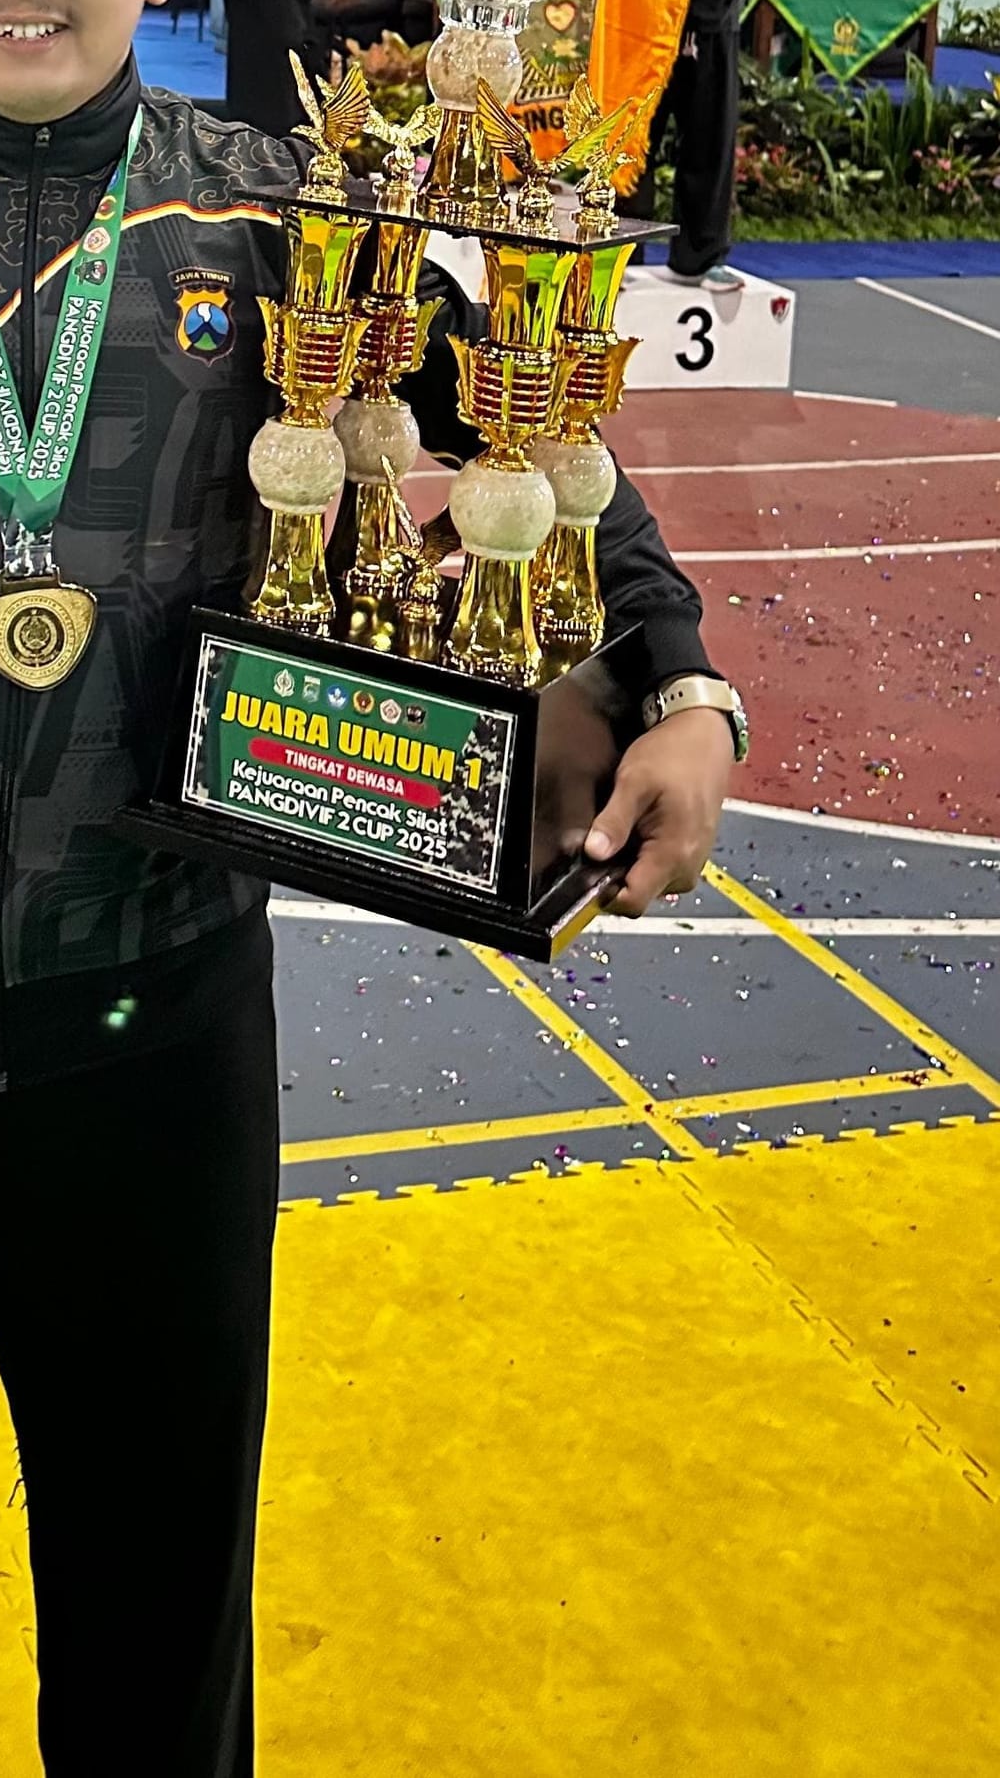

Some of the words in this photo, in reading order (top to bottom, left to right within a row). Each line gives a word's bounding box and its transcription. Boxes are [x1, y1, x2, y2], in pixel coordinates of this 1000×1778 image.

[175, 271, 200, 283] JAWA
[200, 272, 230, 283] TIMUR
[51, 296, 85, 387] PANGDIVIF
[72, 299, 102, 381] Kejuaraan
[675, 306, 714, 372] 3
[40, 401, 61, 436] CUP
[48, 388, 64, 399] 2
[58, 383, 85, 442] Pencak
[27, 438, 52, 480] 2025
[46, 446, 69, 480] Silat
[220, 690, 329, 749] JUARA
[338, 721, 456, 783] UMUM
[464, 757, 482, 791] 1
[233, 759, 328, 802] Kejuaraan
[330, 786, 402, 822] Pencak
[406, 809, 448, 836] Silat
[285, 749, 344, 779] TINGKAT
[347, 766, 405, 796] DEWASA
[228, 779, 336, 826] PANGDIVIF
[336, 812, 350, 831] 2
[352, 817, 394, 842] CUP
[396, 831, 448, 860] 2025
